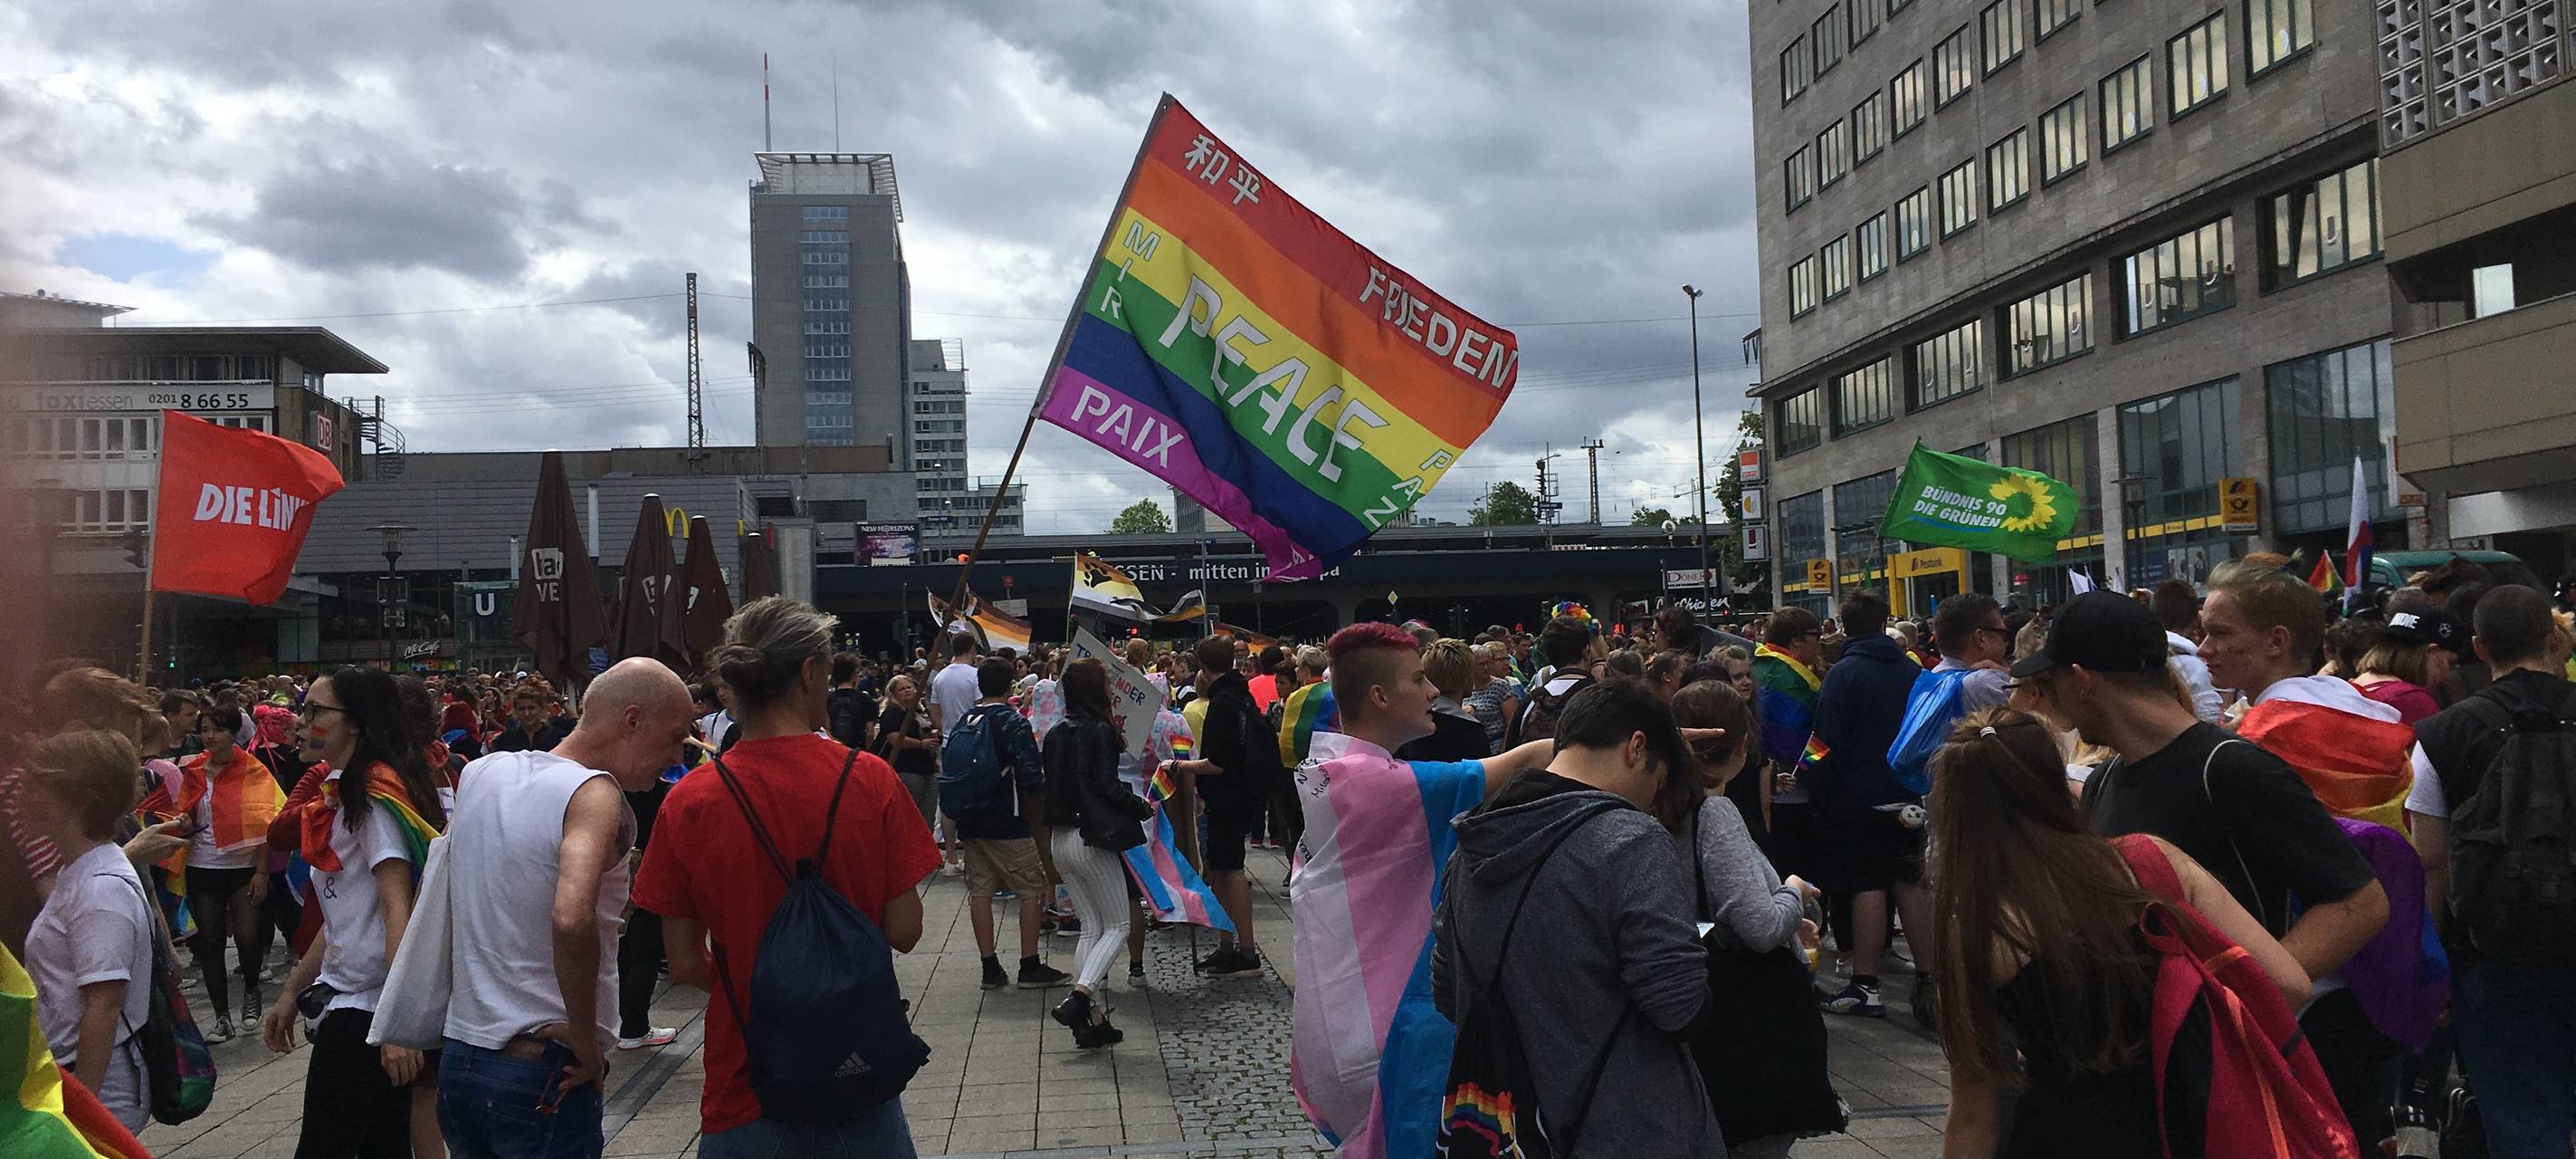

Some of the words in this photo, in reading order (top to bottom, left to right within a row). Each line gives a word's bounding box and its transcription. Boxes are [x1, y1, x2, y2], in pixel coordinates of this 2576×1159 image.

[1184, 133, 1261, 206] 和平
[1099, 220, 1160, 320] MIR
[1358, 265, 1520, 389] FRIEDEN
[1158, 273, 1390, 484] PEACE
[148, 393, 177, 404] 0201
[181, 393, 191, 408] 8
[197, 393, 220, 408] 66
[226, 393, 249, 408] 55
[318, 417, 332, 449] DB
[1070, 385, 1185, 469] PAIX
[1362, 448, 1454, 528] PAZ
[1921, 484, 1984, 511] BÜNDNIS
[1986, 501, 2007, 516] 90
[194, 483, 254, 525] DIE
[258, 487, 310, 532] LIN
[1913, 499, 1939, 516] DIE
[1939, 507, 2001, 528] GRÜNEN
[1188, 562, 1249, 580] mitten
[1255, 561, 1271, 580] in
[474, 592, 495, 617] U
[323, 876, 338, 899] &
[834, 1064, 872, 1078] adidas
